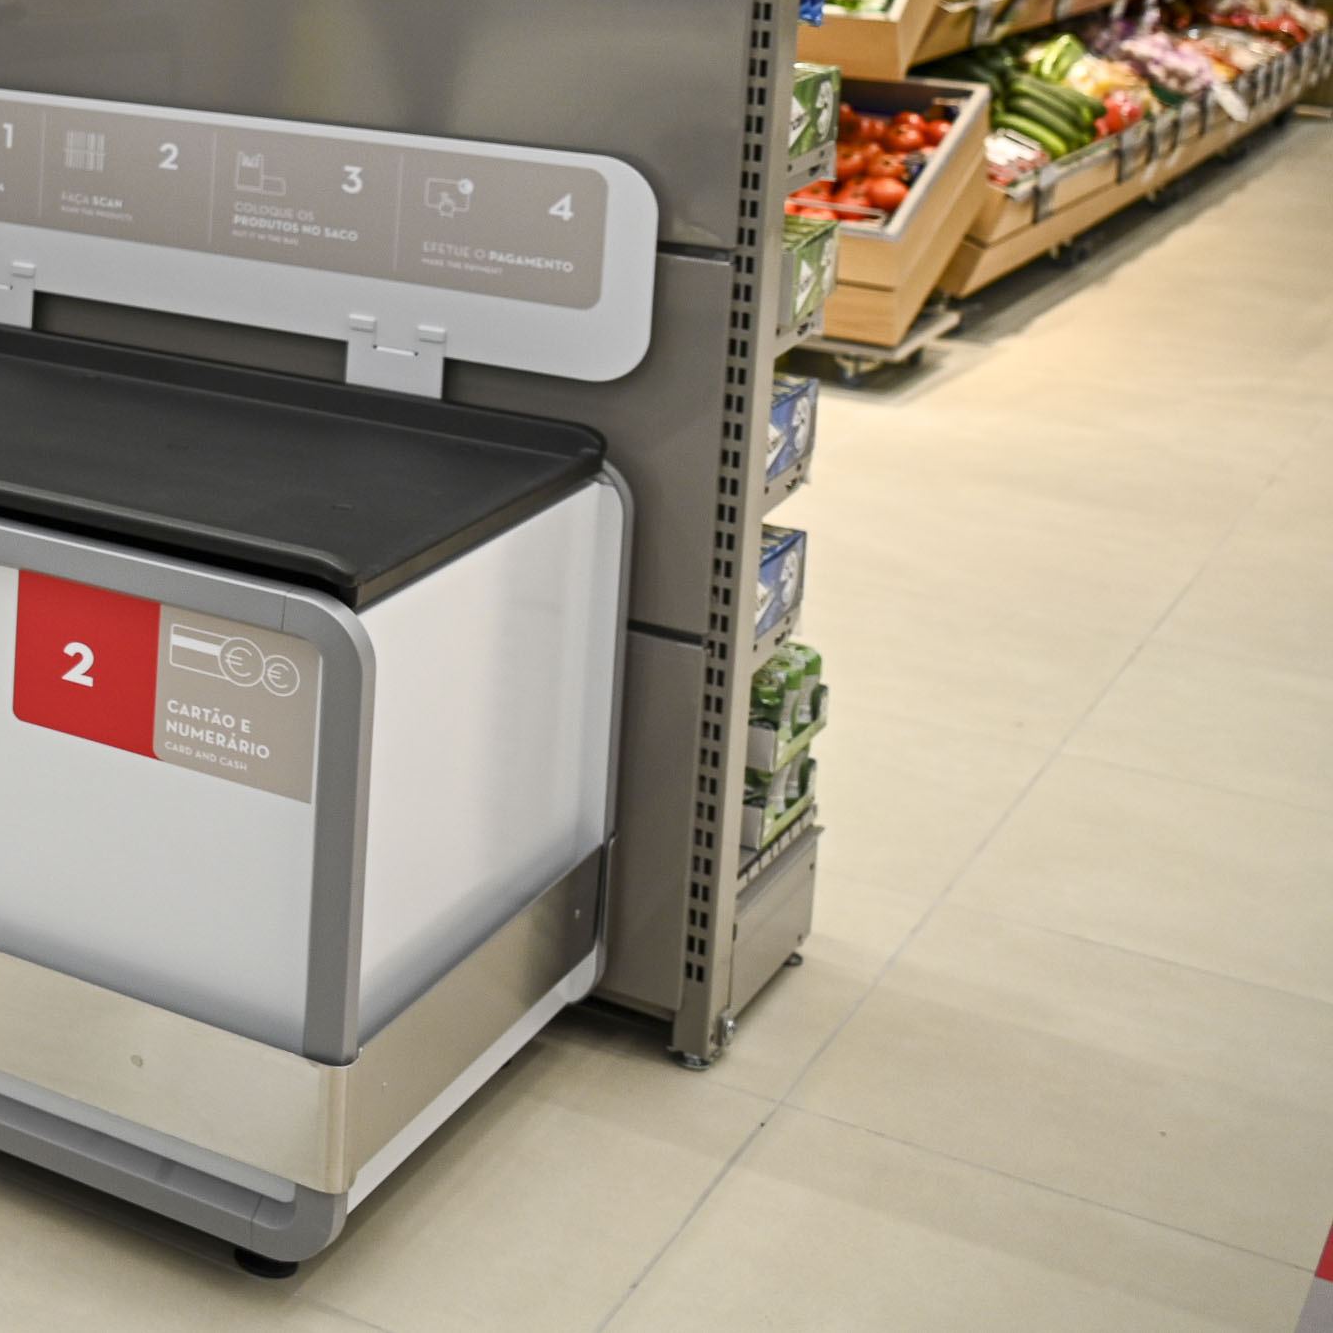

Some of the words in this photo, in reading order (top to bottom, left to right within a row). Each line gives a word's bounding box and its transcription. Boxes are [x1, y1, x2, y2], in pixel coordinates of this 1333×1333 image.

[1, 123, 14, 149] 1
[159, 143, 179, 171] 2
[341, 164, 363, 194] 3
[93, 194, 125, 209] SCAN
[234, 201, 293, 219] COLOQUE
[298, 210, 315, 222] OS
[547, 193, 574, 221] 4
[234, 214, 300, 234] PRODUTOS
[301, 225, 321, 236] NO
[324, 227, 358, 242] SACO
[423, 242, 469, 259] EFETUE
[474, 248, 486, 260] O
[488, 250, 574, 274] PAGAMENTO
[62, 641, 95, 688] 2
[167, 699, 235, 728] CARTÃO
[241, 719, 251, 733] E
[166, 719, 270, 759] NUMERÁRIO
[164, 741, 193, 756] CARD
[195, 749, 217, 763] AND
[219, 757, 248, 771] CASH
